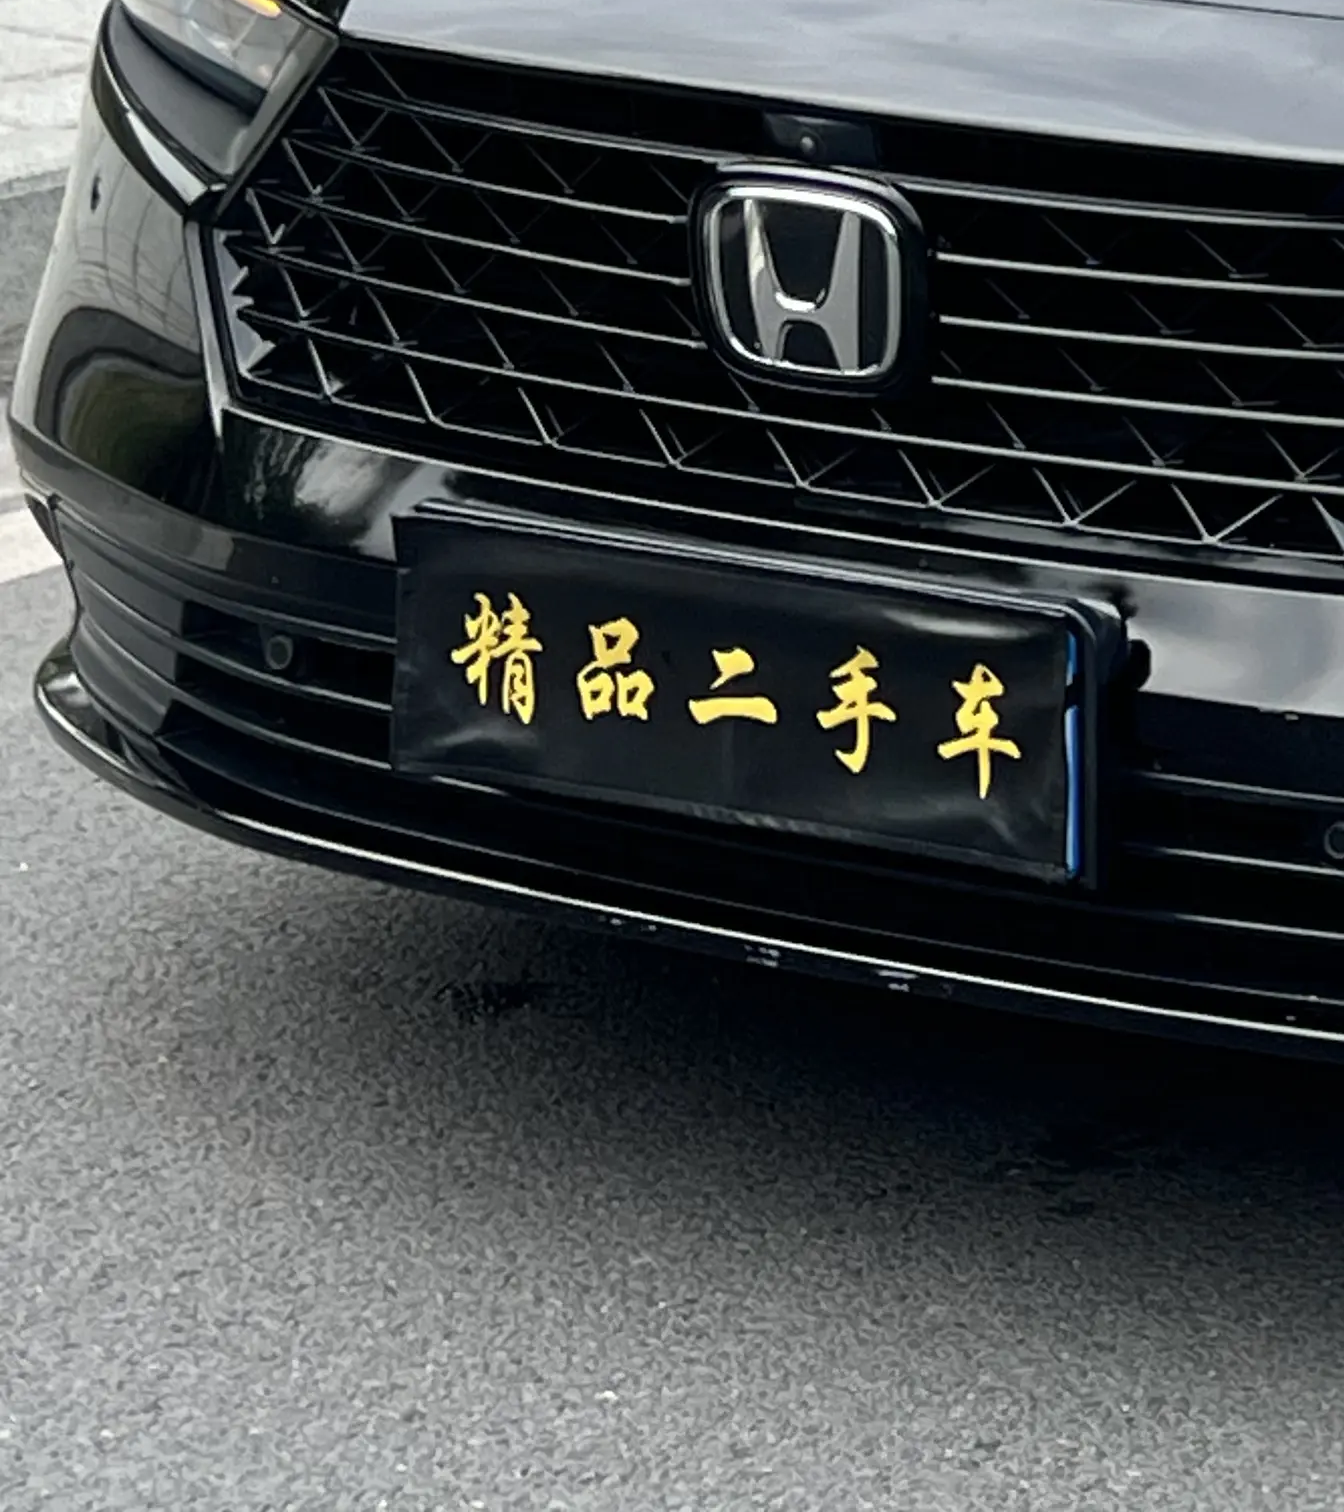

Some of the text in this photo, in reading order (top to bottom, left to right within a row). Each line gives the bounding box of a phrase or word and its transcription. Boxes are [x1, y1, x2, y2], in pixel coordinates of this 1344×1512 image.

[742, 197, 863, 375] H
[451, 592, 1022, 799] 精品二手车
